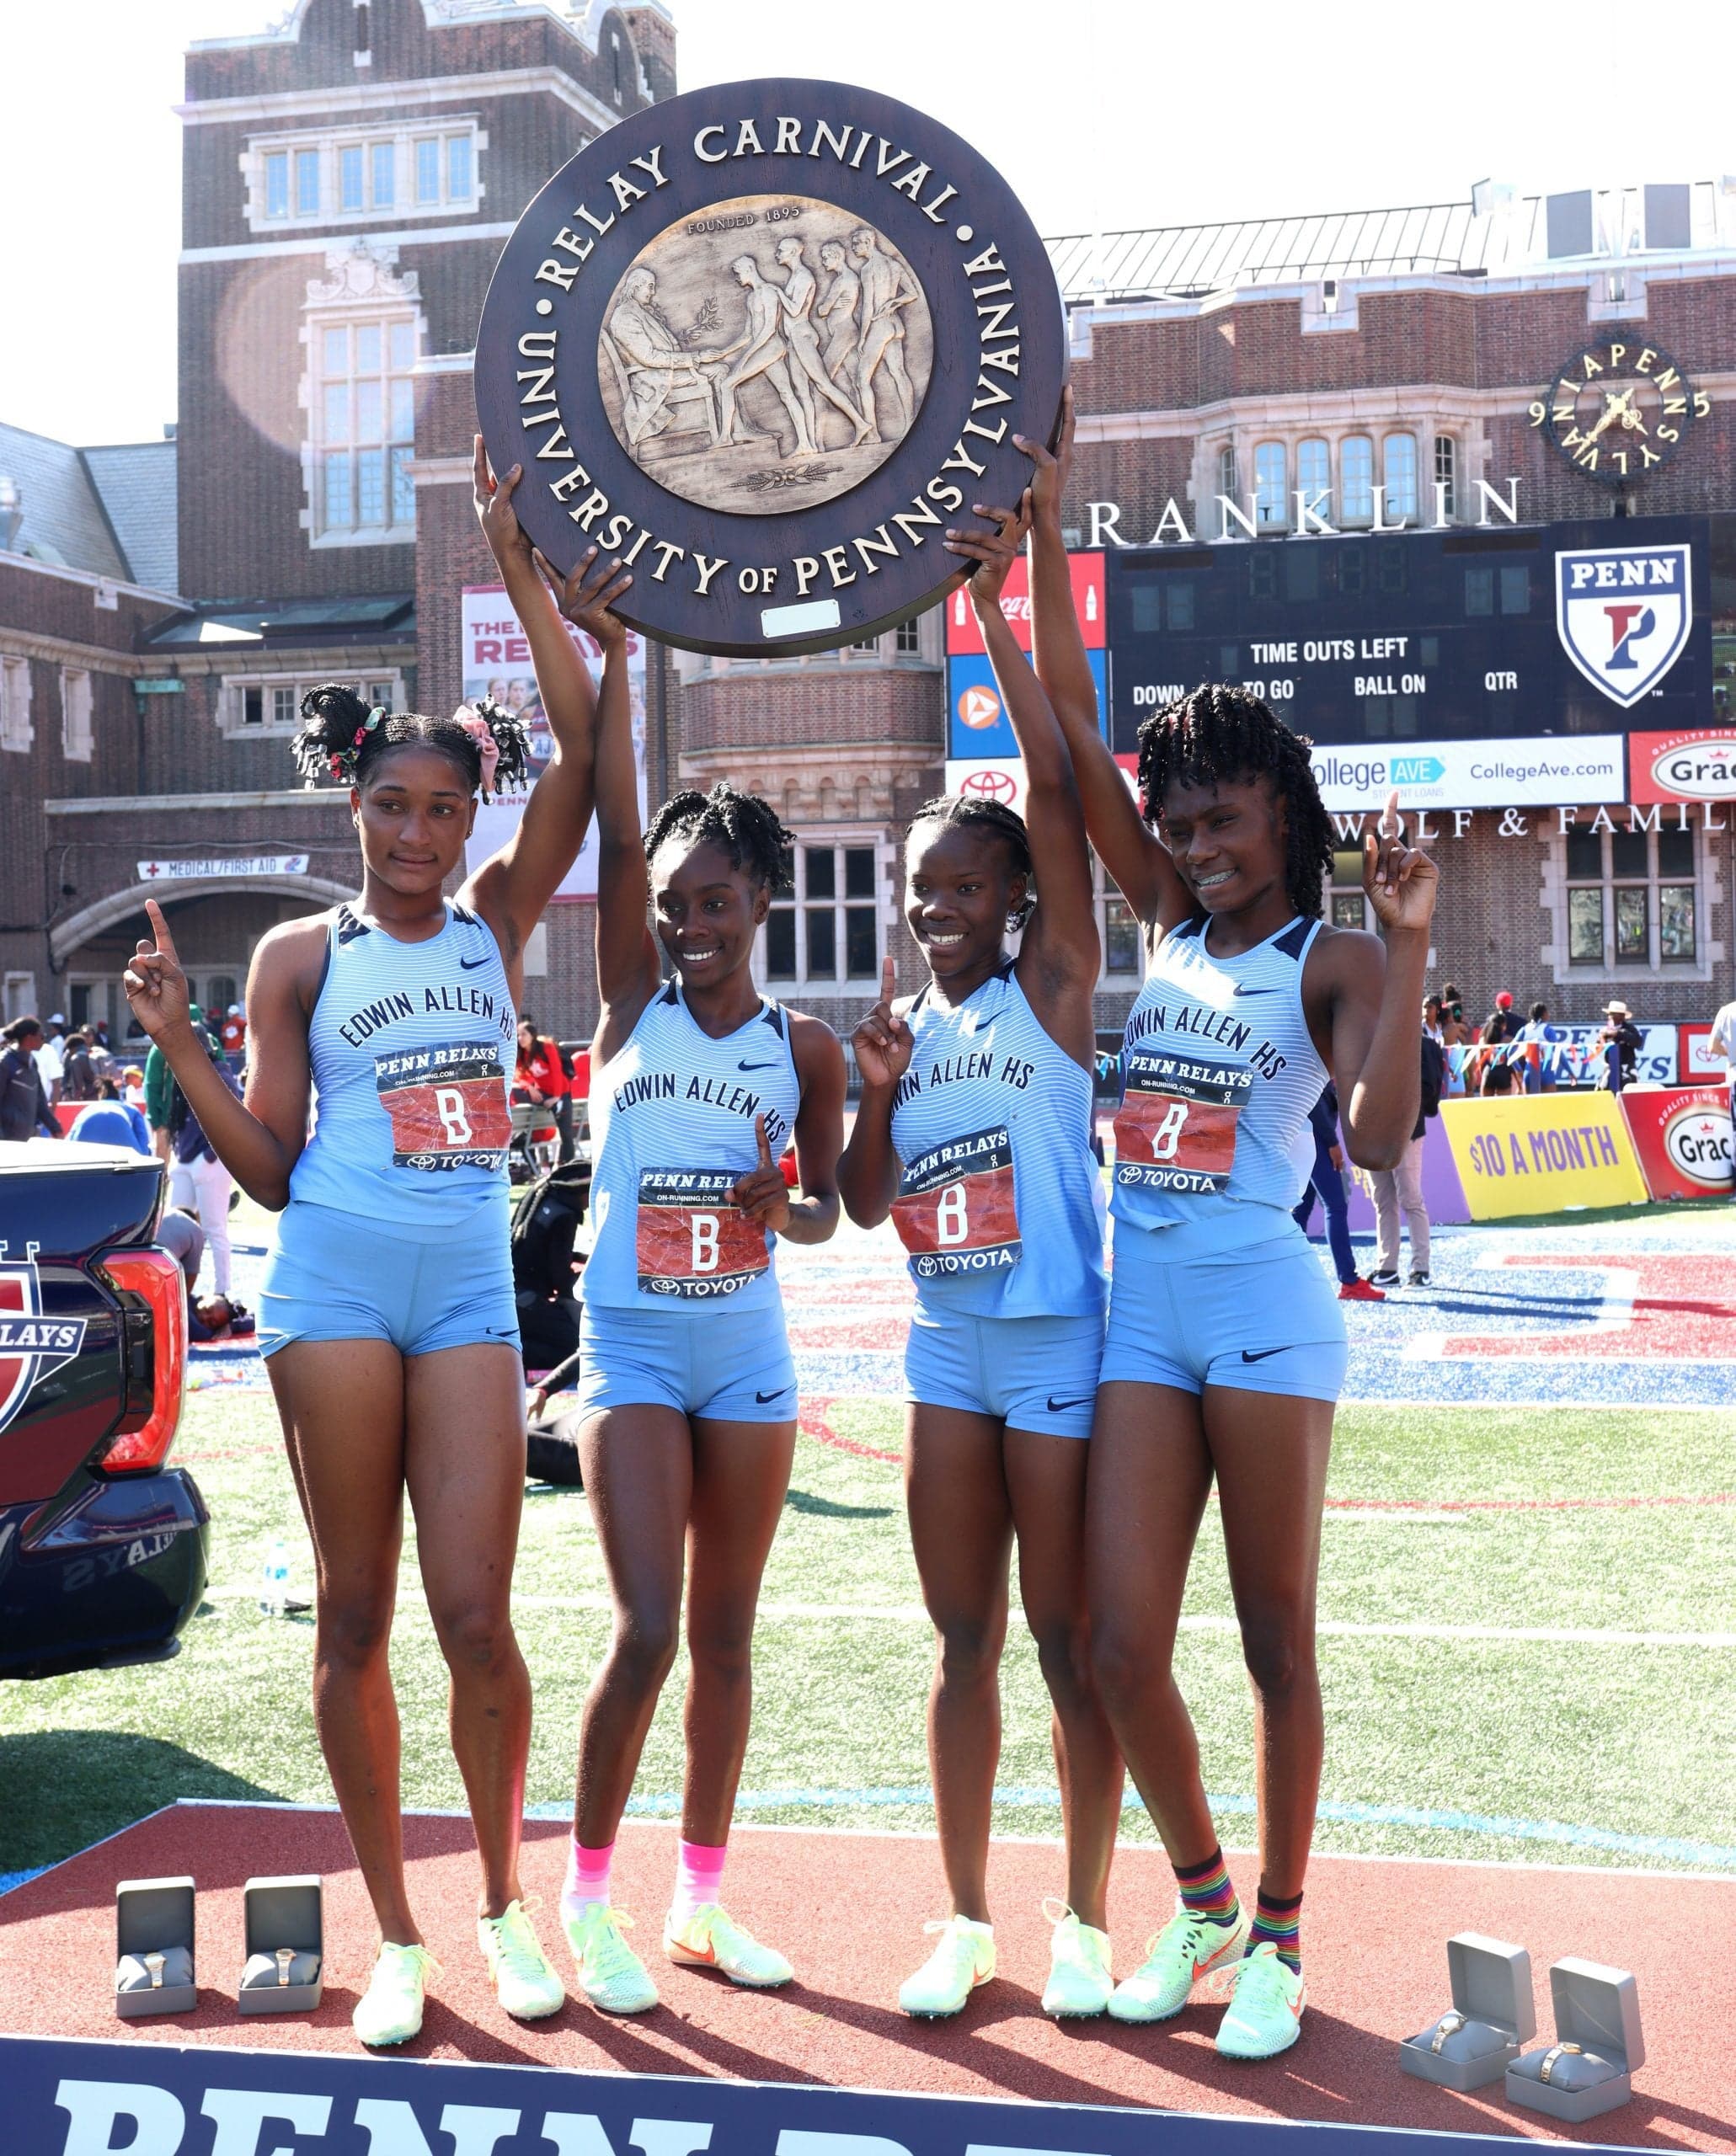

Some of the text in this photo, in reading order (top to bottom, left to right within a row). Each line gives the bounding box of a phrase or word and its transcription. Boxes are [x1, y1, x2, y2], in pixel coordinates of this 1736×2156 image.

[535, 115, 964, 295] RELAY CARNIVAL
[687, 206, 799, 234] FOUNDED 1895
[516, 242, 1021, 596] UNIVERSITY OF PENNSYLVANIA
[1571, 558, 1677, 589] PENN
[470, 622, 514, 636] THE
[1251, 638, 1408, 664] TIME OUTS LEFT
[1133, 684, 1185, 705] DOWN
[1270, 679, 1295, 700] GO
[1354, 675, 1426, 696] BALL ON
[1485, 671, 1519, 691] QTR
[1651, 731, 1706, 756] QUALITY
[1394, 760, 1432, 782] AVE
[1471, 761, 1613, 782] CollegeAve.com
[1498, 807, 1529, 836] &
[258, 857, 276, 873] AID
[339, 986, 515, 1049] EDWIN ALLEN HS
[1174, 1006, 1252, 1051] ALLEN
[1249, 1040, 1287, 1081] HS
[376, 1046, 498, 1076] PENN RELAYS
[930, 1053, 994, 1088] ALLEN
[1001, 1056, 1035, 1090] HS
[1130, 1055, 1175, 1075] PENN
[1178, 1063, 1254, 1088] RELAYS
[435, 1088, 473, 1145] B
[613, 1073, 786, 1143] EDWIN ALLEN HS
[1659, 1096, 1690, 1126] QUALITY
[1692, 1091, 1720, 1105] SINCE
[1152, 1103, 1188, 1160] B
[942, 1132, 1008, 1162] RELAYS
[1470, 1125, 1619, 1177] $10 A MONTH
[441, 1155, 502, 1169] TOYOTA
[640, 1174, 694, 1188] PENN
[1142, 1170, 1215, 1192] TOYOTA
[656, 1194, 719, 1203] ON-RUNNING.COM
[937, 1182, 969, 1245] B
[691, 1214, 720, 1272] B
[937, 1249, 1013, 1273] TOYOTA
[683, 1274, 756, 1296] TOYOTA
